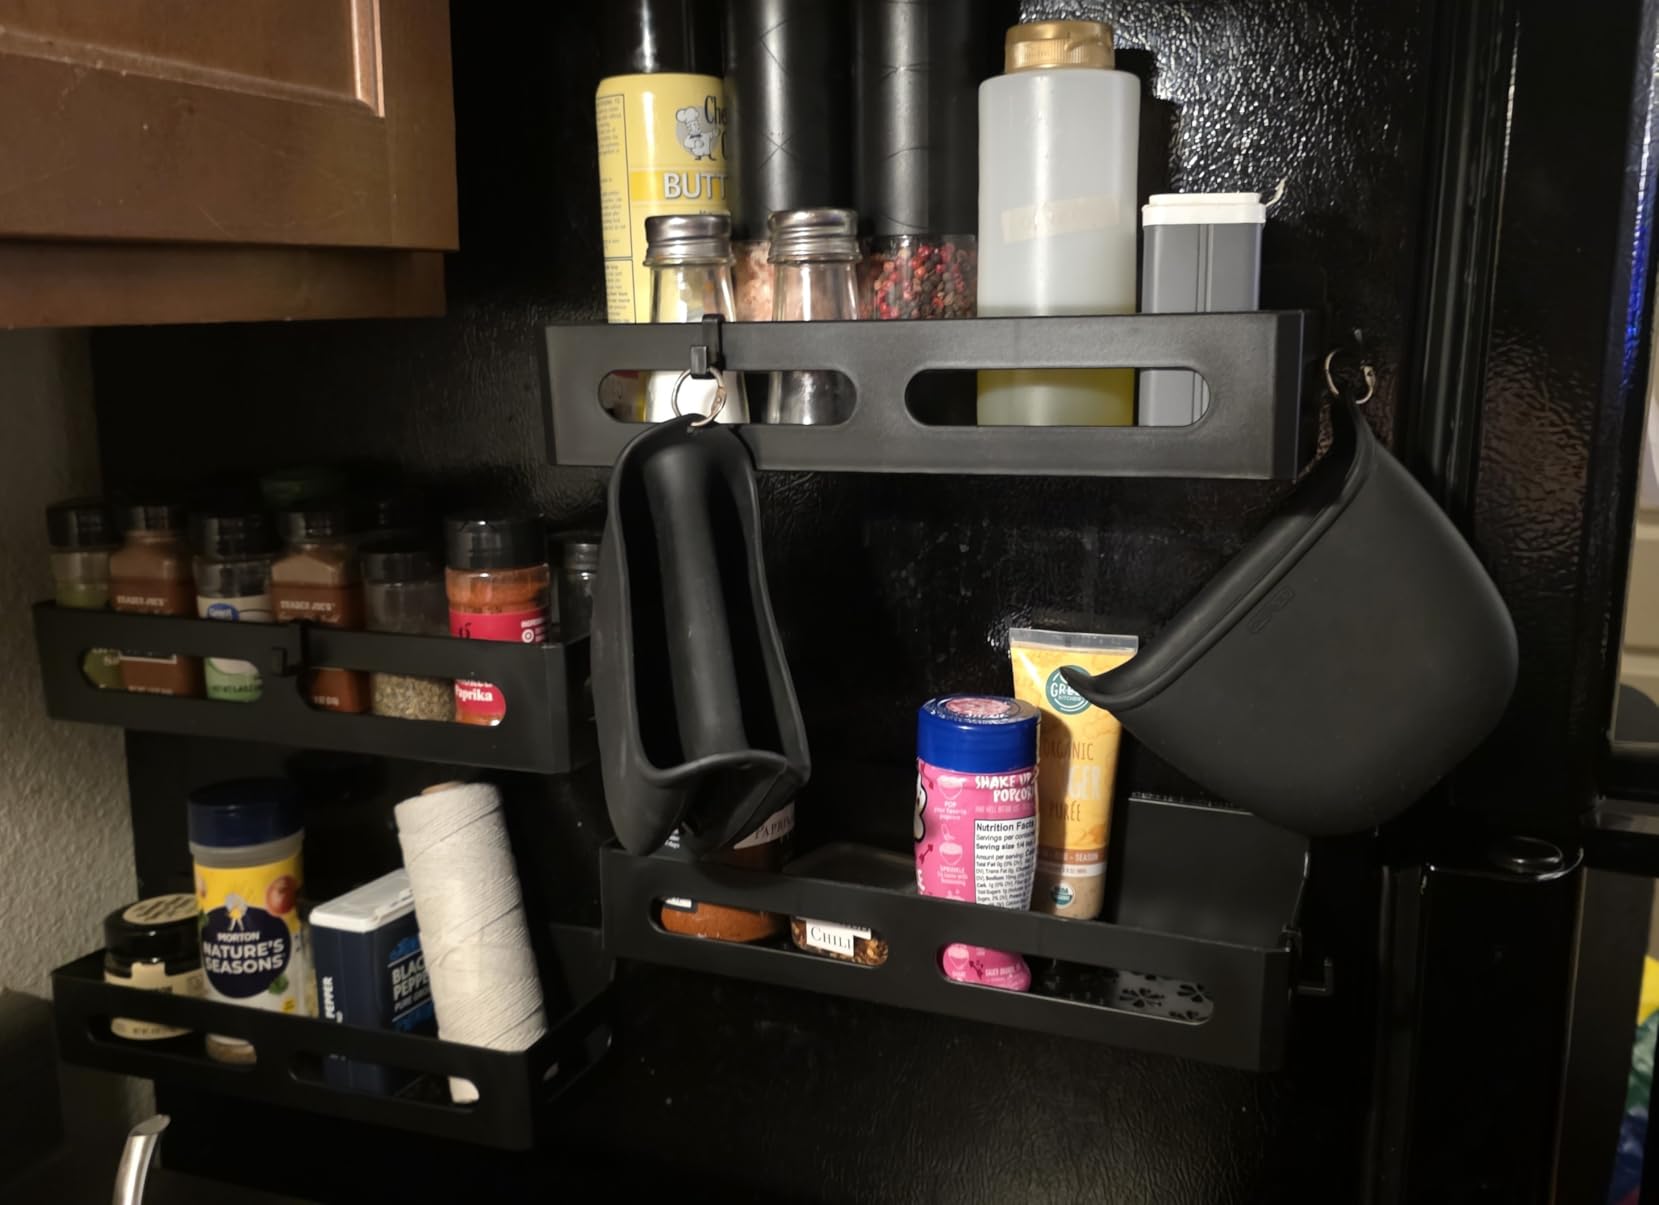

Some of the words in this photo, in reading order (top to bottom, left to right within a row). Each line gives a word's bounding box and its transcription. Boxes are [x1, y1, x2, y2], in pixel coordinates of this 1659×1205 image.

[663, 172, 728, 200] BUTT
[975, 775, 1016, 790] SHAKE
[976, 823, 1014, 833] Nutrition
[976, 843, 1000, 851] Serving
[216, 931, 260, 943] MORTON
[810, 926, 852, 951] CHILI
[202, 938, 285, 960] NATURE'S
[204, 954, 284, 975] SEASONS
[391, 955, 427, 986] BLAC
